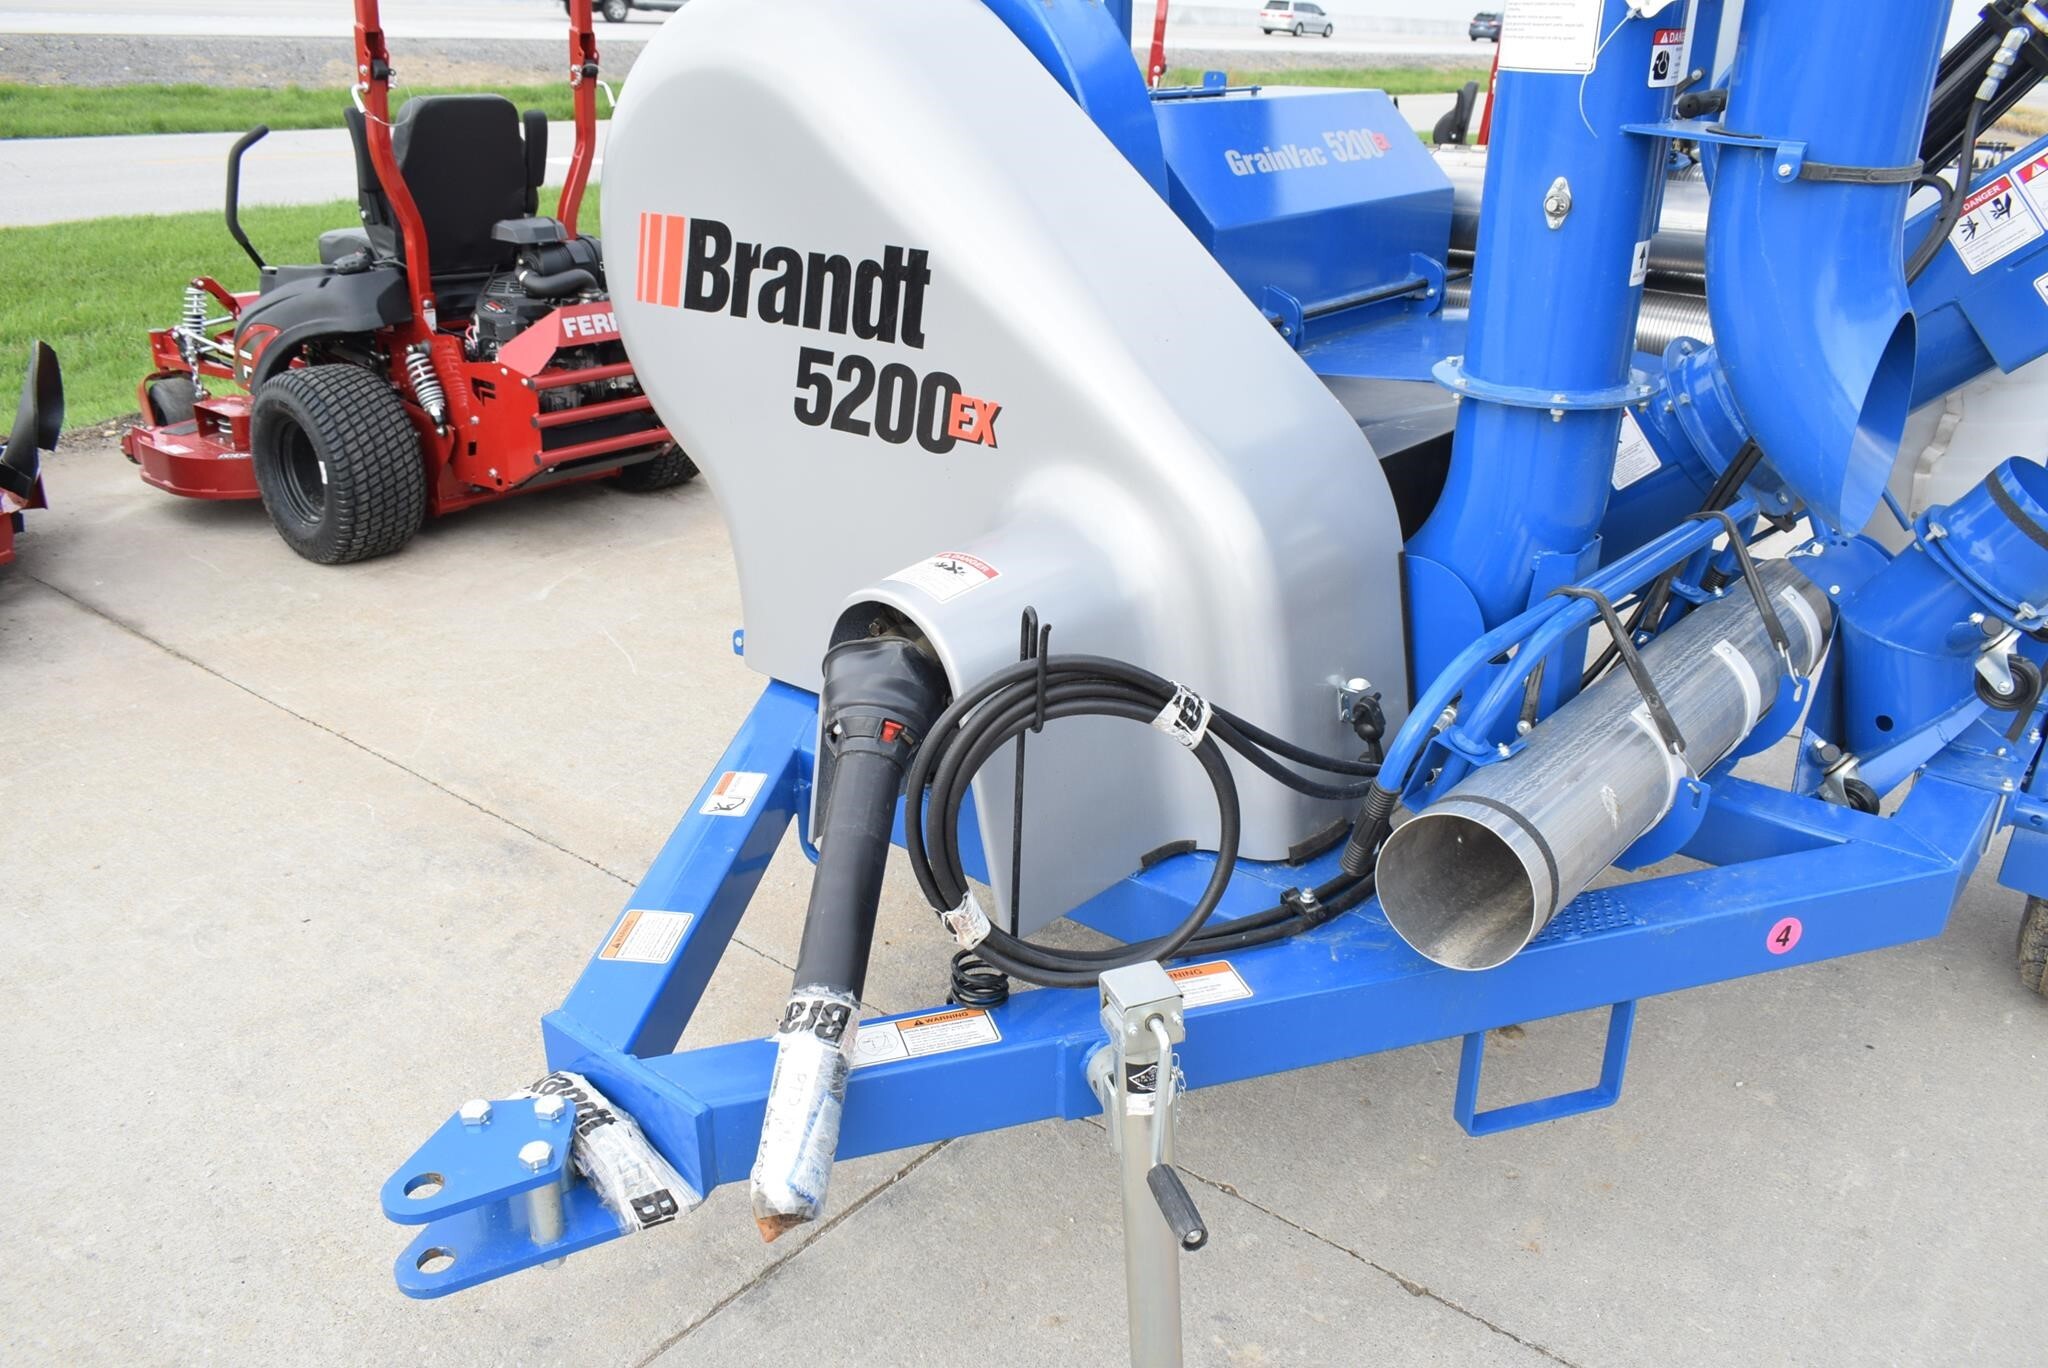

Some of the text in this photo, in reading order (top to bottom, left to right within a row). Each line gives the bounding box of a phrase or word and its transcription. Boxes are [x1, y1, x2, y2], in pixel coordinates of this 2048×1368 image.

[1224, 144, 1328, 176] GrainVac
[1963, 185, 2002, 211] DANGER
[684, 218, 931, 349] Brandt
[1776, 925, 1792, 947] 4
[925, 1011, 969, 1024] WARNING
